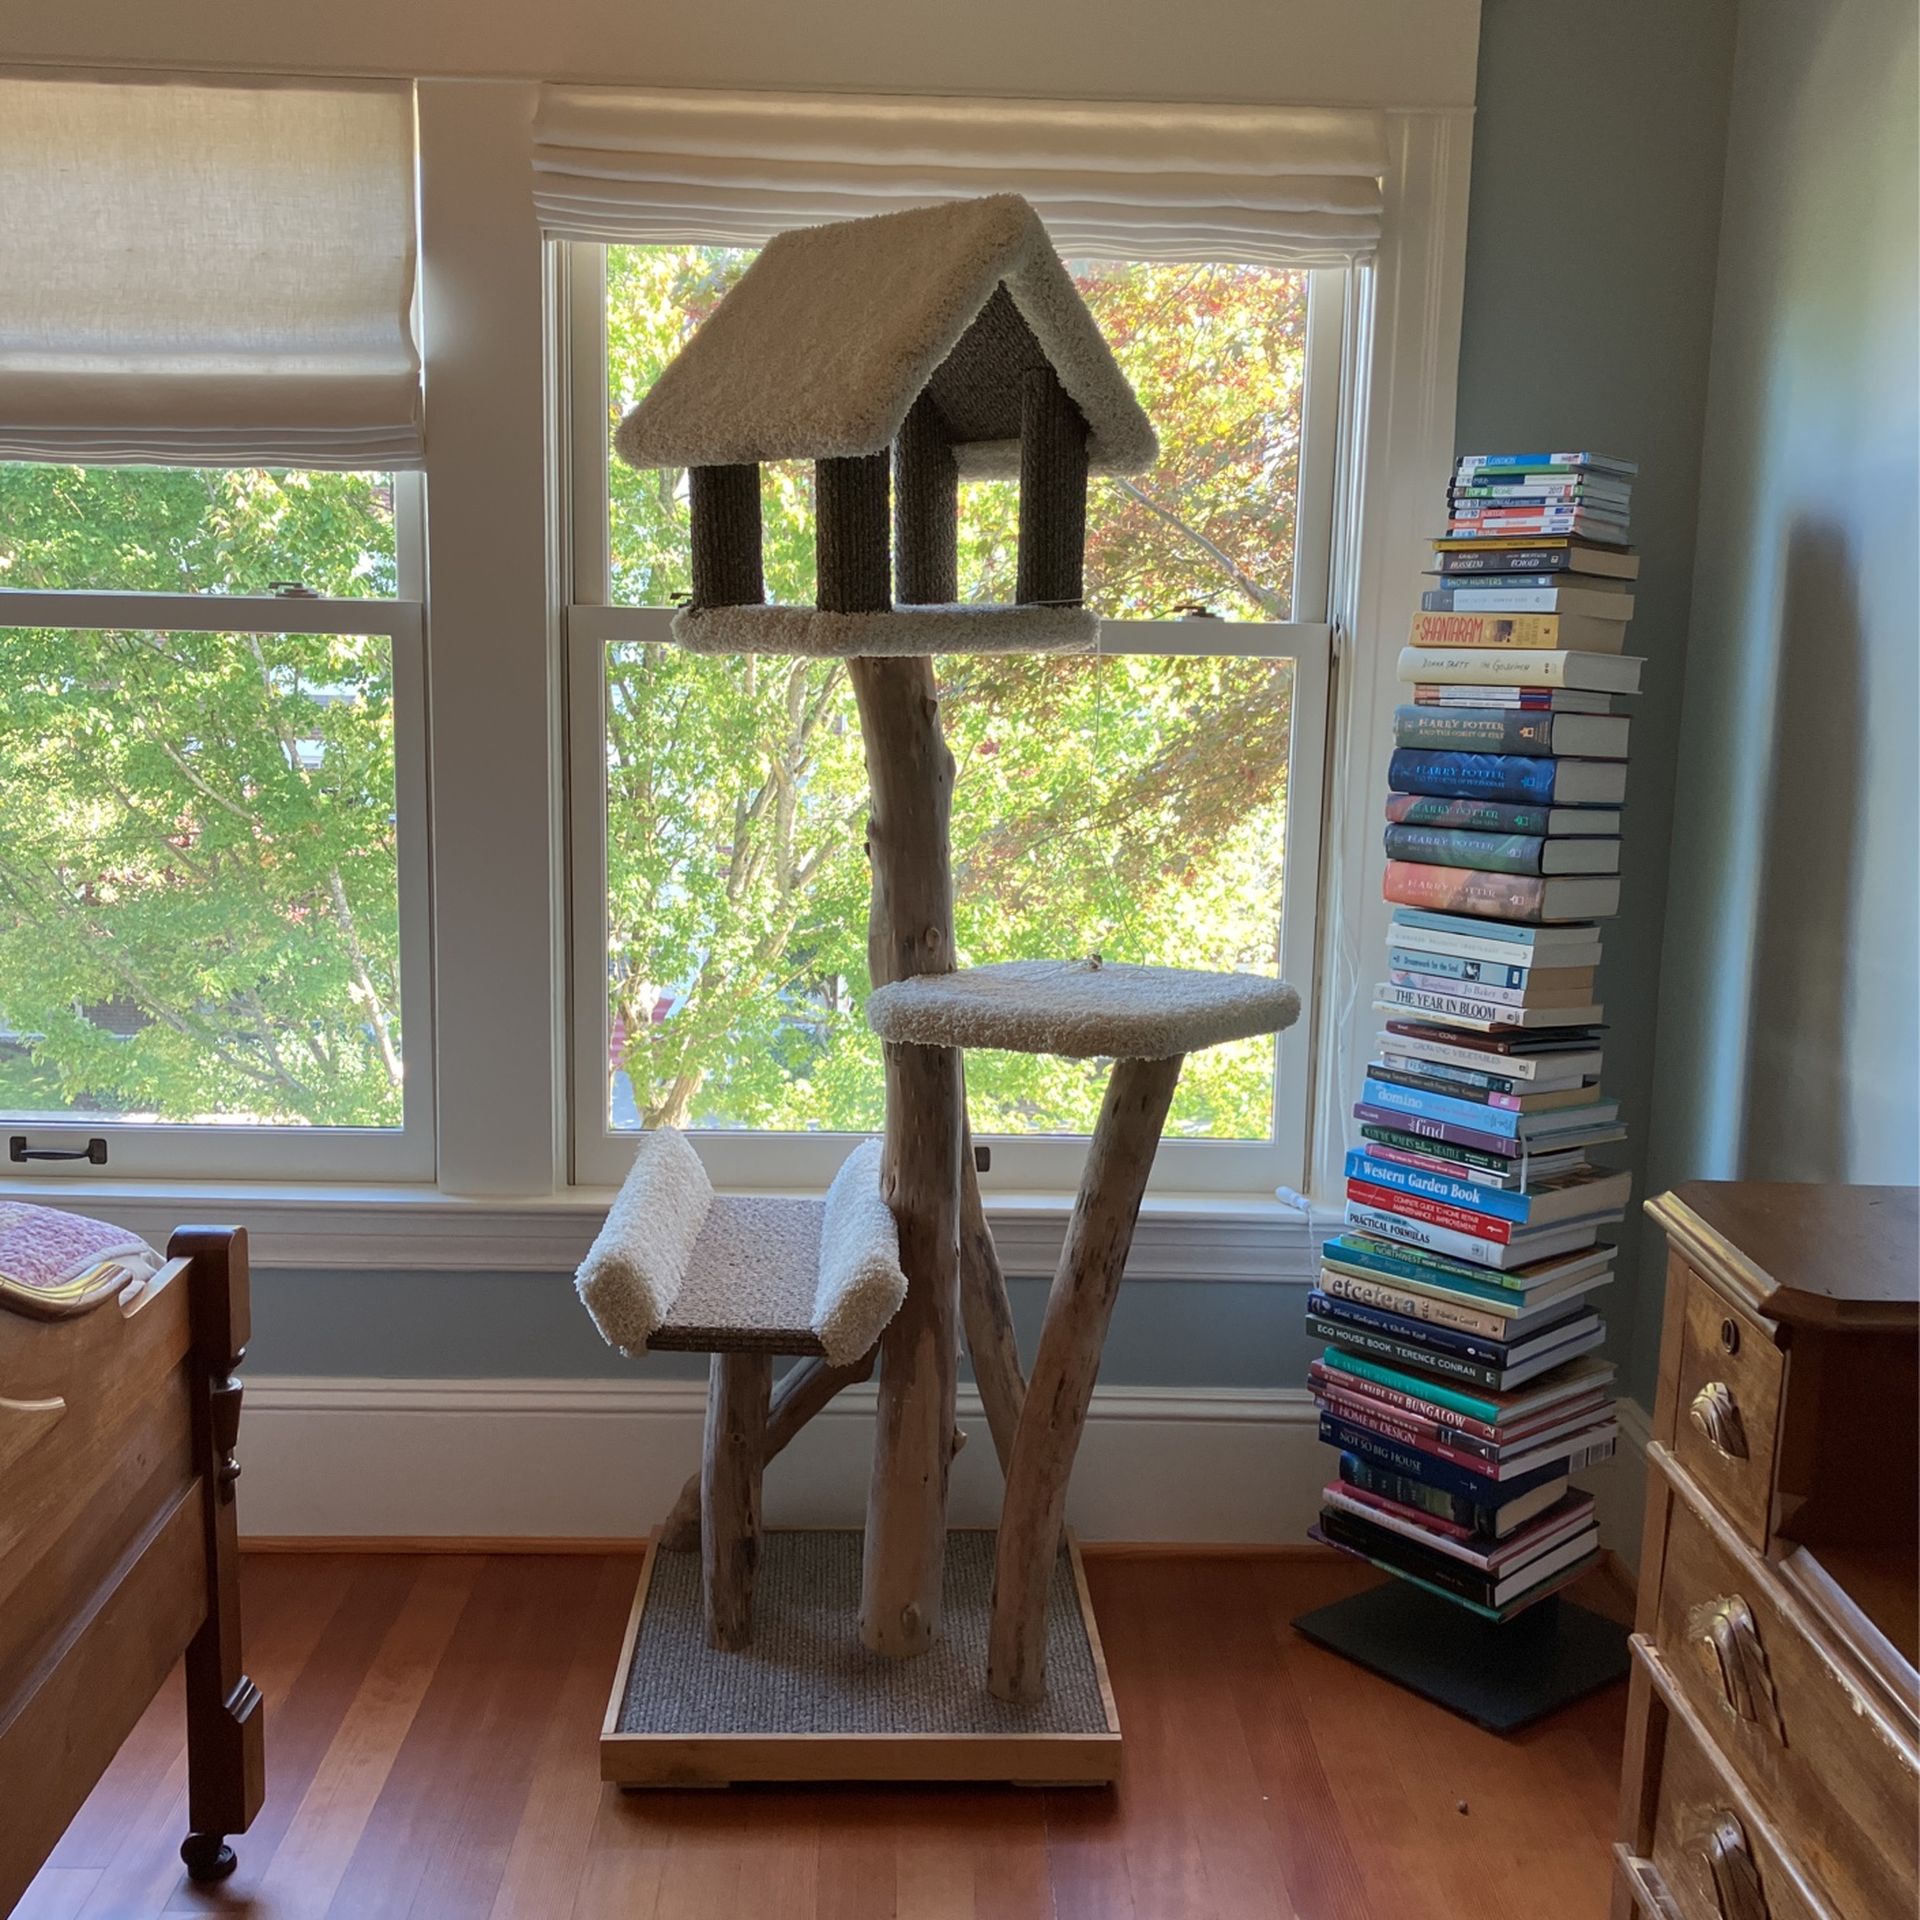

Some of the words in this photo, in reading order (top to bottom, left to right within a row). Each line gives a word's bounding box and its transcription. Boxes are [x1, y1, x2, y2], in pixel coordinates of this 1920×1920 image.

[1470, 577, 1502, 586] HUNTERS
[1420, 615, 1484, 643] SHANTARAM
[1419, 718, 1459, 729] HARRY
[1463, 720, 1504, 732] POTTER
[1416, 766, 1457, 776] HARRY
[1462, 768, 1505, 780] POTTER
[1408, 835, 1449, 846] HARRY
[1452, 839, 1494, 851] POTTER
[1395, 989, 1415, 1003] THE
[1417, 994, 1444, 1010] YEAR
[1446, 1000, 1459, 1012] IN
[1460, 1001, 1497, 1021] BLOOM
[1378, 1088, 1424, 1108] domino
[1416, 1118, 1444, 1139] find
[1362, 1161, 1406, 1186] Western
[1408, 1173, 1448, 1197] Garden
[1450, 1183, 1480, 1205] Book
[1350, 1213, 1388, 1231] PRACTICAL
[1390, 1224, 1430, 1243] FORMULAS
[1375, 1245, 1421, 1264] NORTHWEST
[1332, 1278, 1416, 1315] etcetera
[1317, 1324, 1334, 1336] ECO
[1335, 1328, 1364, 1345] HOUSE
[1366, 1338, 1391, 1352] BOOK
[1396, 1346, 1436, 1366] TERENCE
[1437, 1358, 1476, 1377] CONRAN
[1360, 1382, 1385, 1398] INSIDE
[1388, 1392, 1402, 1404] THE
[1405, 1397, 1466, 1428] BUNGALOW
[1339, 1406, 1368, 1425] HOME
[1379, 1421, 1417, 1445] DESIGN
[1340, 1431, 1358, 1446] NOT
[1360, 1439, 1372, 1451] SO
[1373, 1445, 1388, 1458] BIG
[1391, 1451, 1422, 1470] HOUSE
